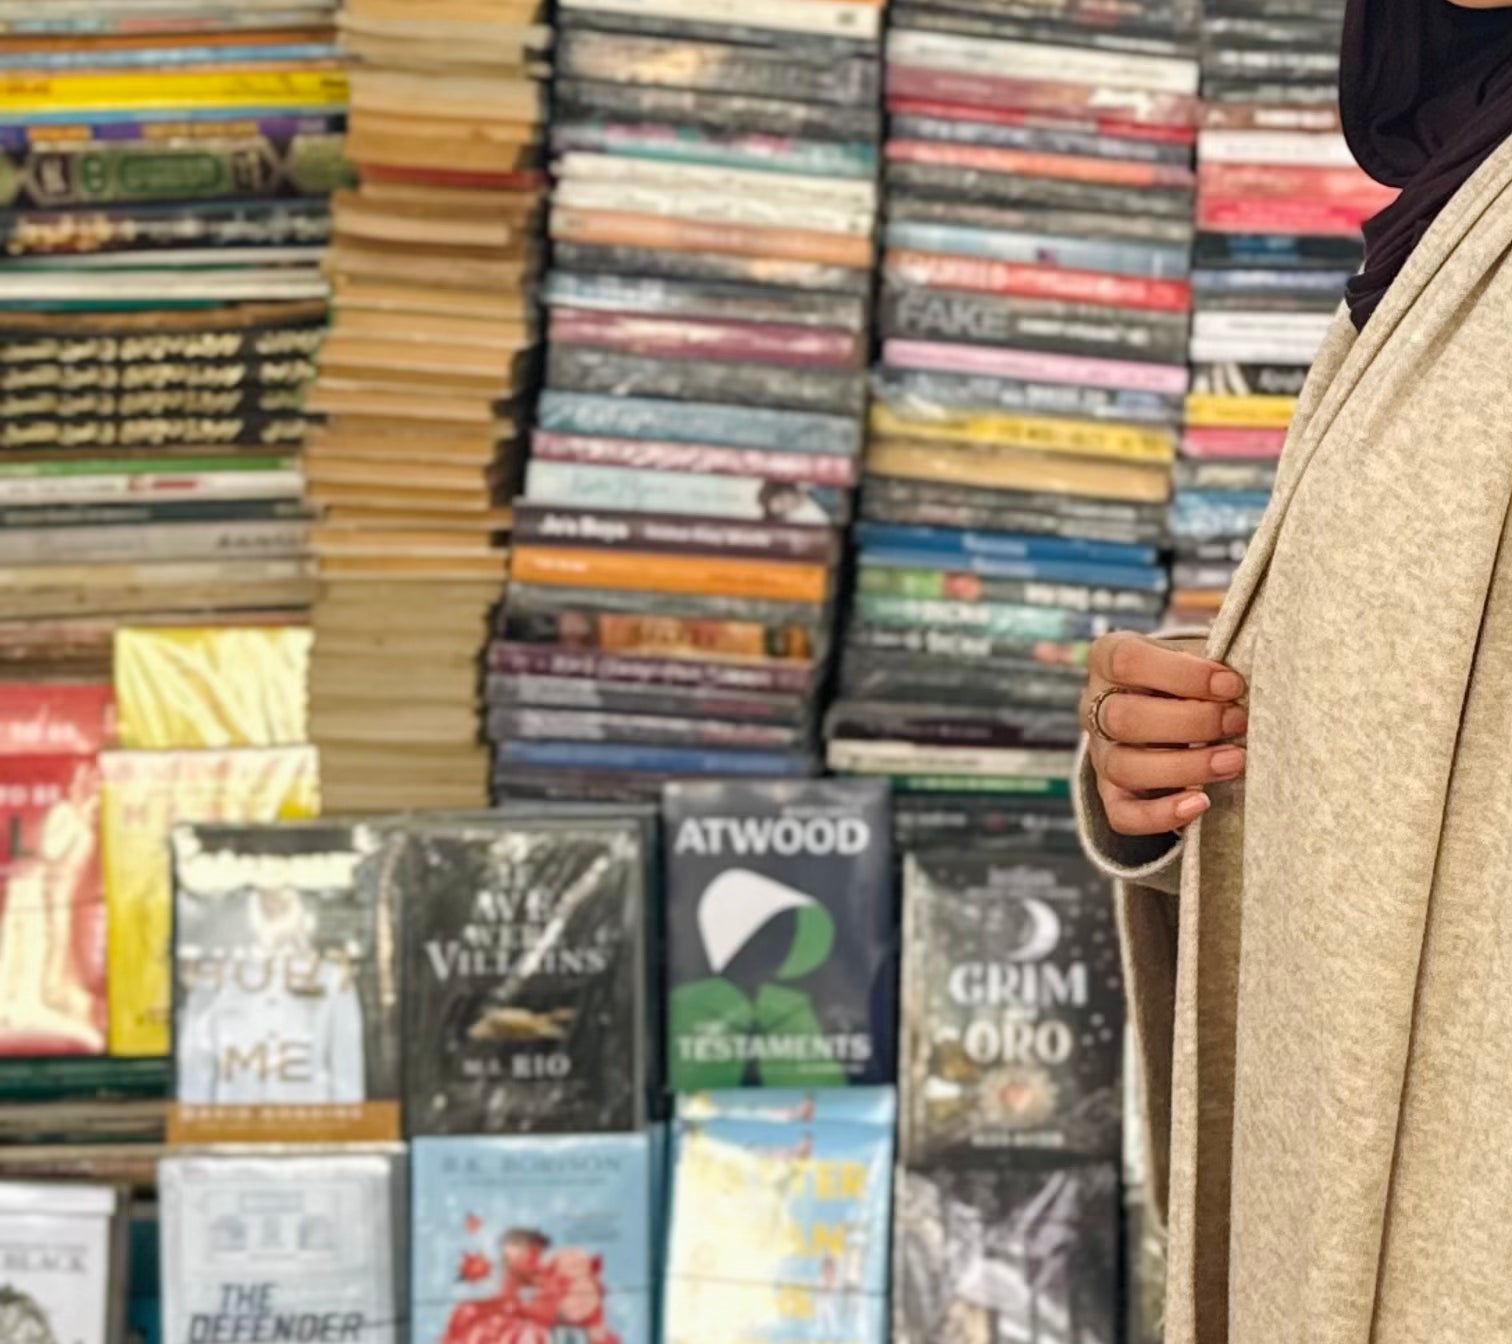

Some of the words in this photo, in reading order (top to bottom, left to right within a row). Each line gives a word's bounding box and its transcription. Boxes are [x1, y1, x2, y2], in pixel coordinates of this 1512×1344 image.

[674, 816, 871, 854] ATWOOD
[948, 961, 1089, 1006] GRIM
[676, 1032, 872, 1061] TESTAMENTS
[964, 1019, 1074, 1063] ORO
[222, 1041, 314, 1084] ME
[511, 1052, 573, 1079] RIO
[219, 1283, 278, 1311] THE
